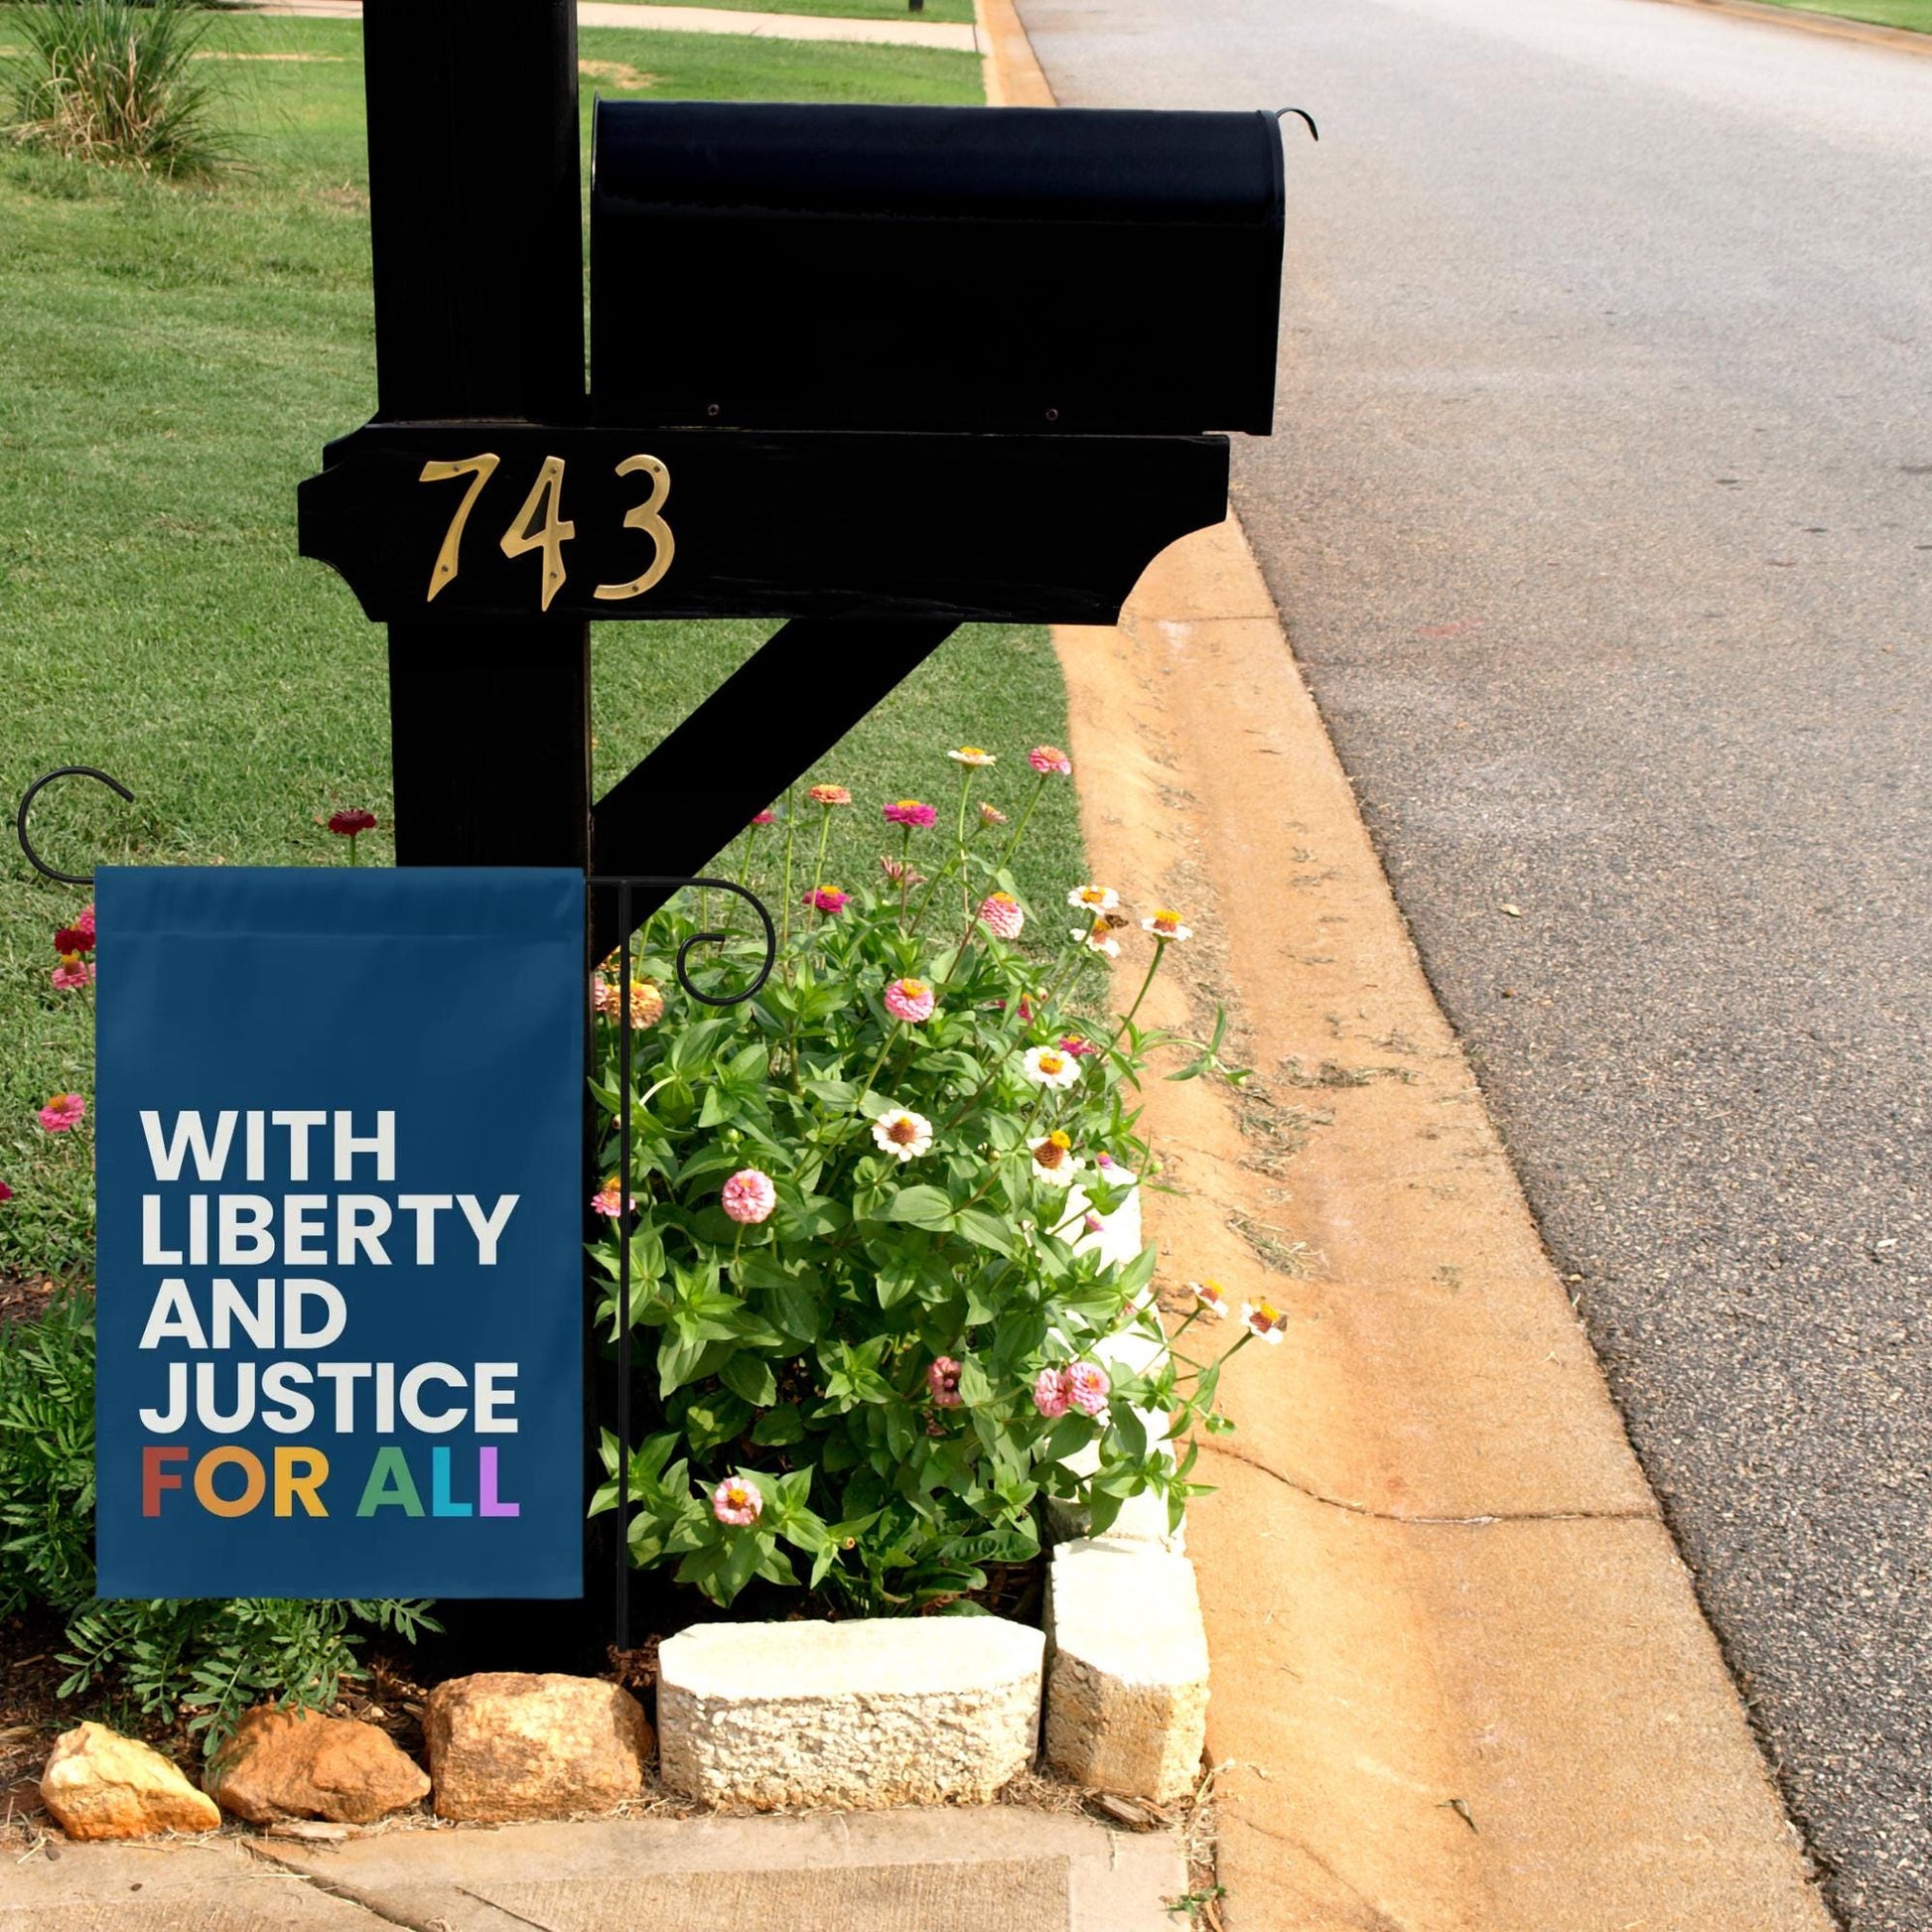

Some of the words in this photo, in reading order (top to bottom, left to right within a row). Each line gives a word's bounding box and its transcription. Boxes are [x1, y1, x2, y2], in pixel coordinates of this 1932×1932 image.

[419, 453, 676, 612] 743
[139, 1110, 396, 1181] WITH
[142, 1194, 520, 1266] LIBERTY
[139, 1278, 347, 1349] AND
[139, 1362, 519, 1435] JUSTICE
[142, 1446, 330, 1518] FOR
[355, 1447, 520, 1517] ALL
